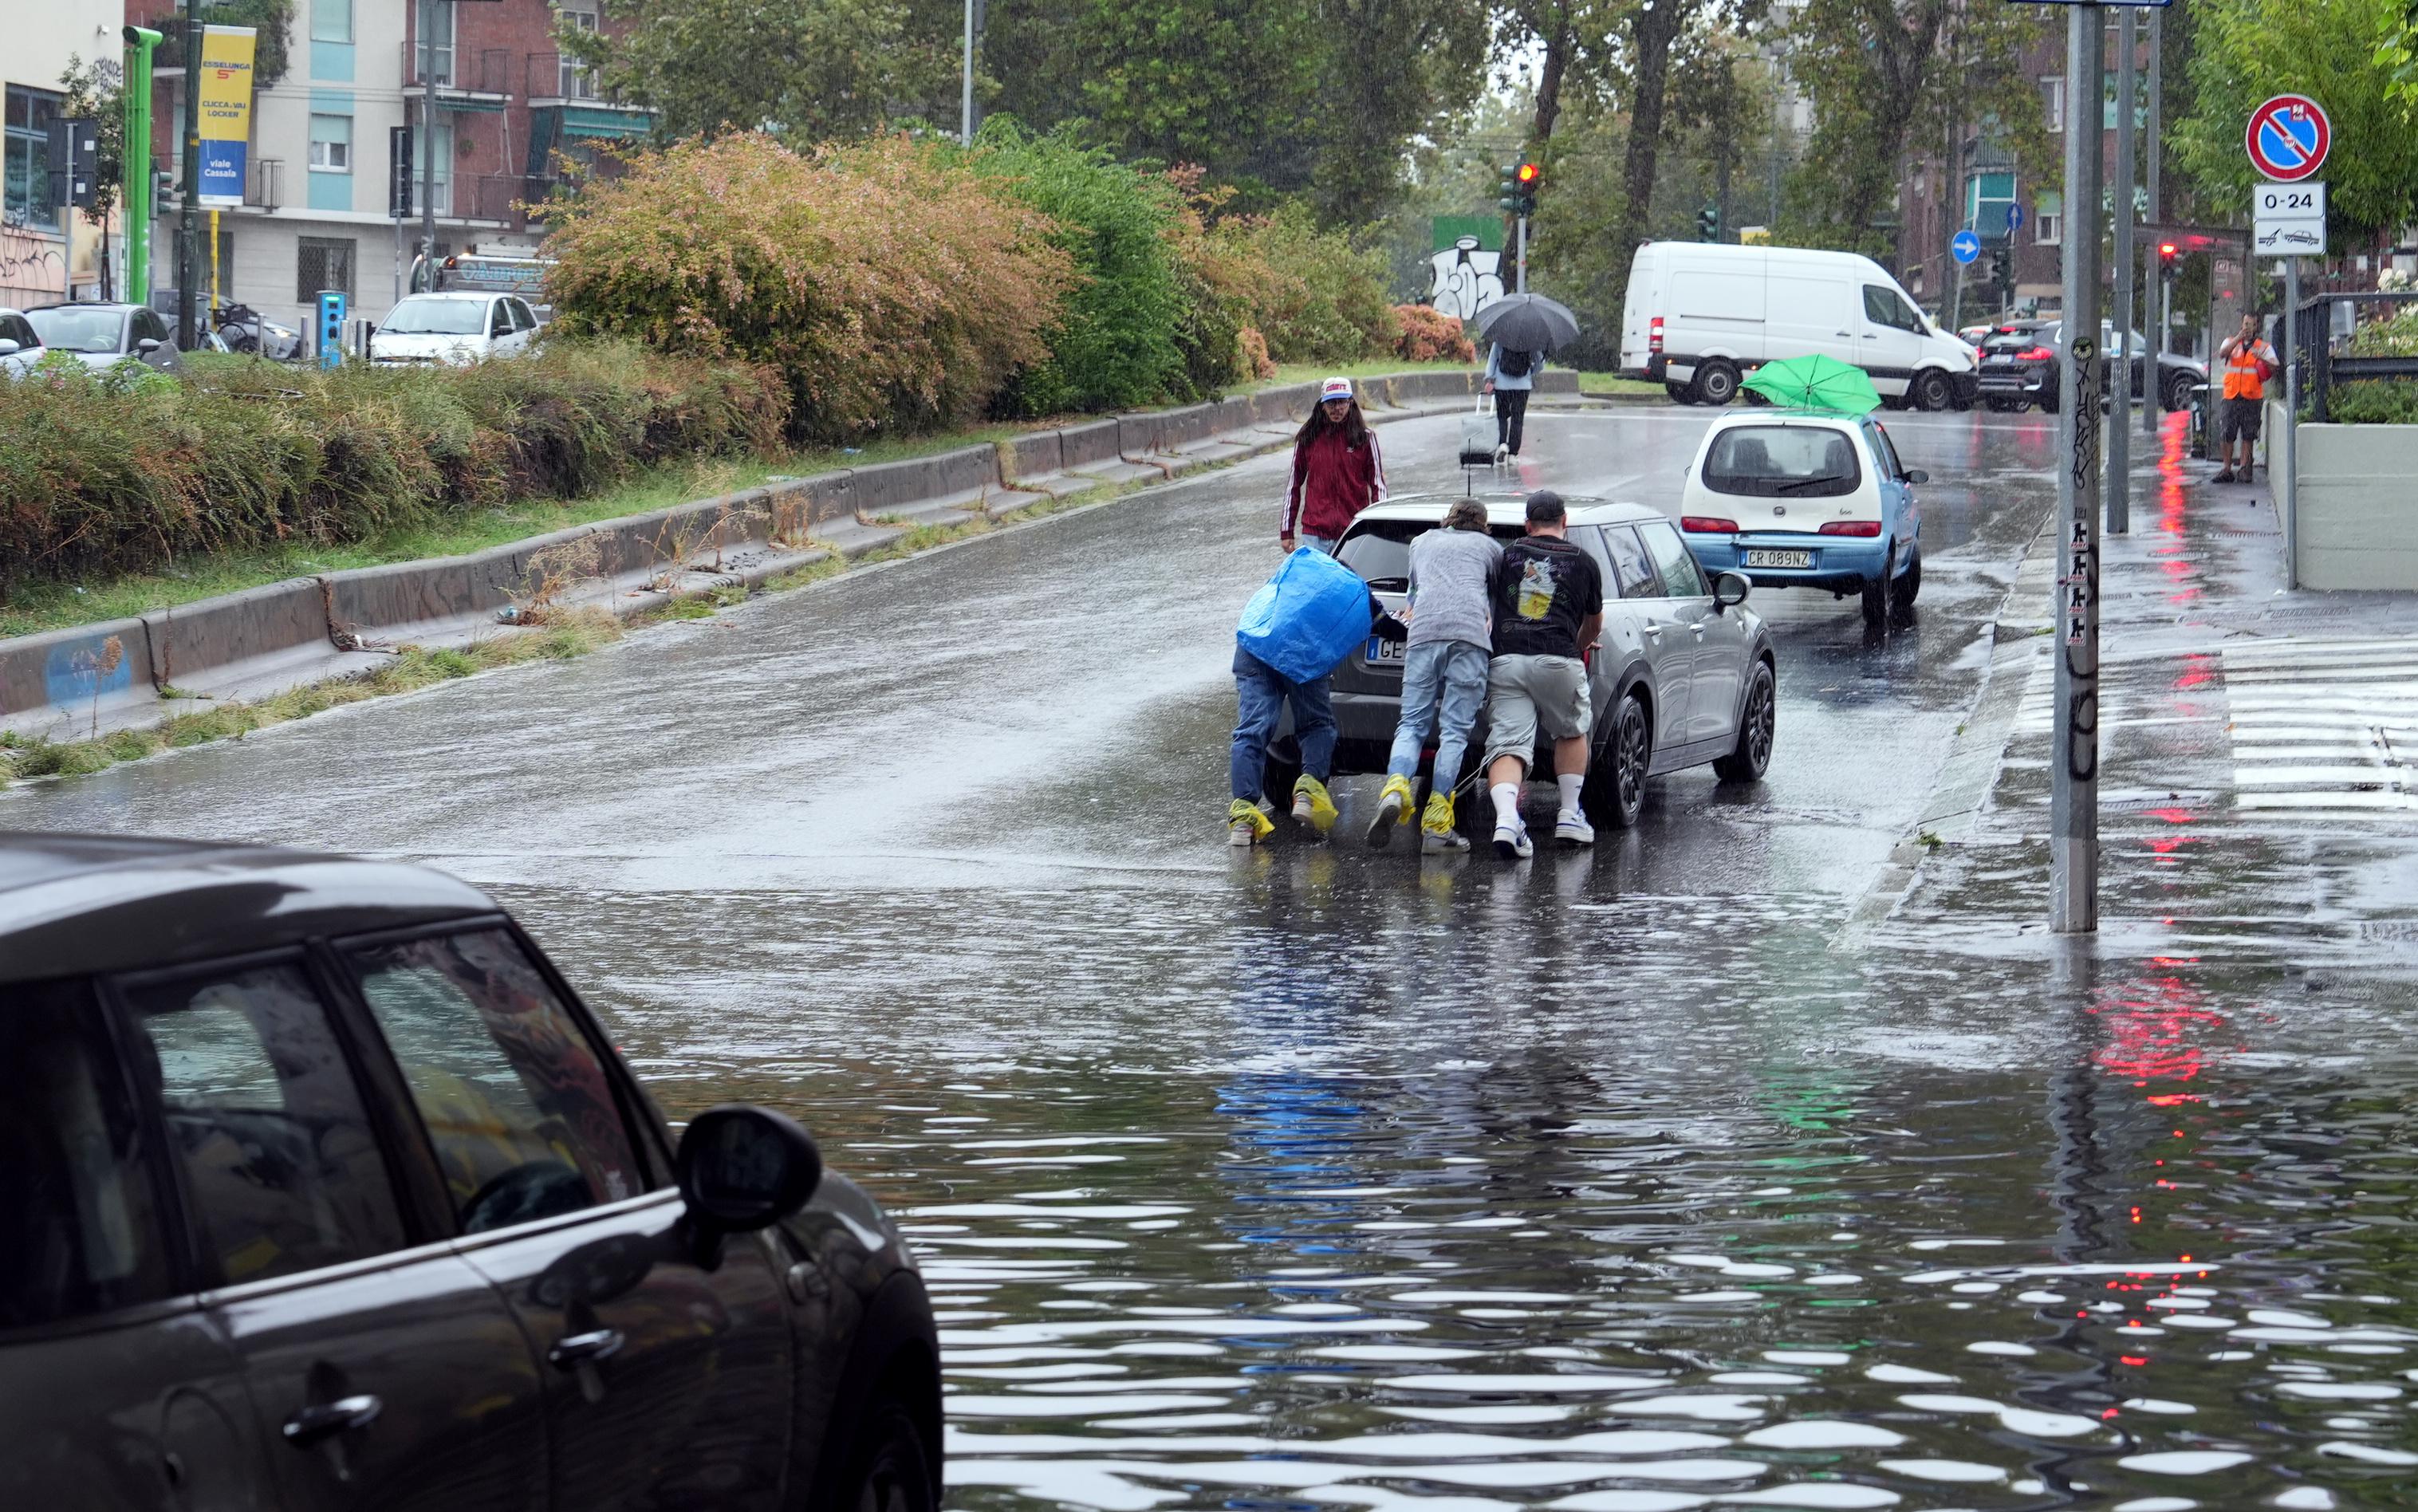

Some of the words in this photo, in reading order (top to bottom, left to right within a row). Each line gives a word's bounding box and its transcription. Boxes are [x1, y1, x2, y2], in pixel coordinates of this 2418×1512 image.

[2265, 194, 2314, 209] 0-24
[1749, 552, 1764, 565] CR
[1768, 551, 1810, 566] 089NZ
[1381, 640, 1402, 658] GE
